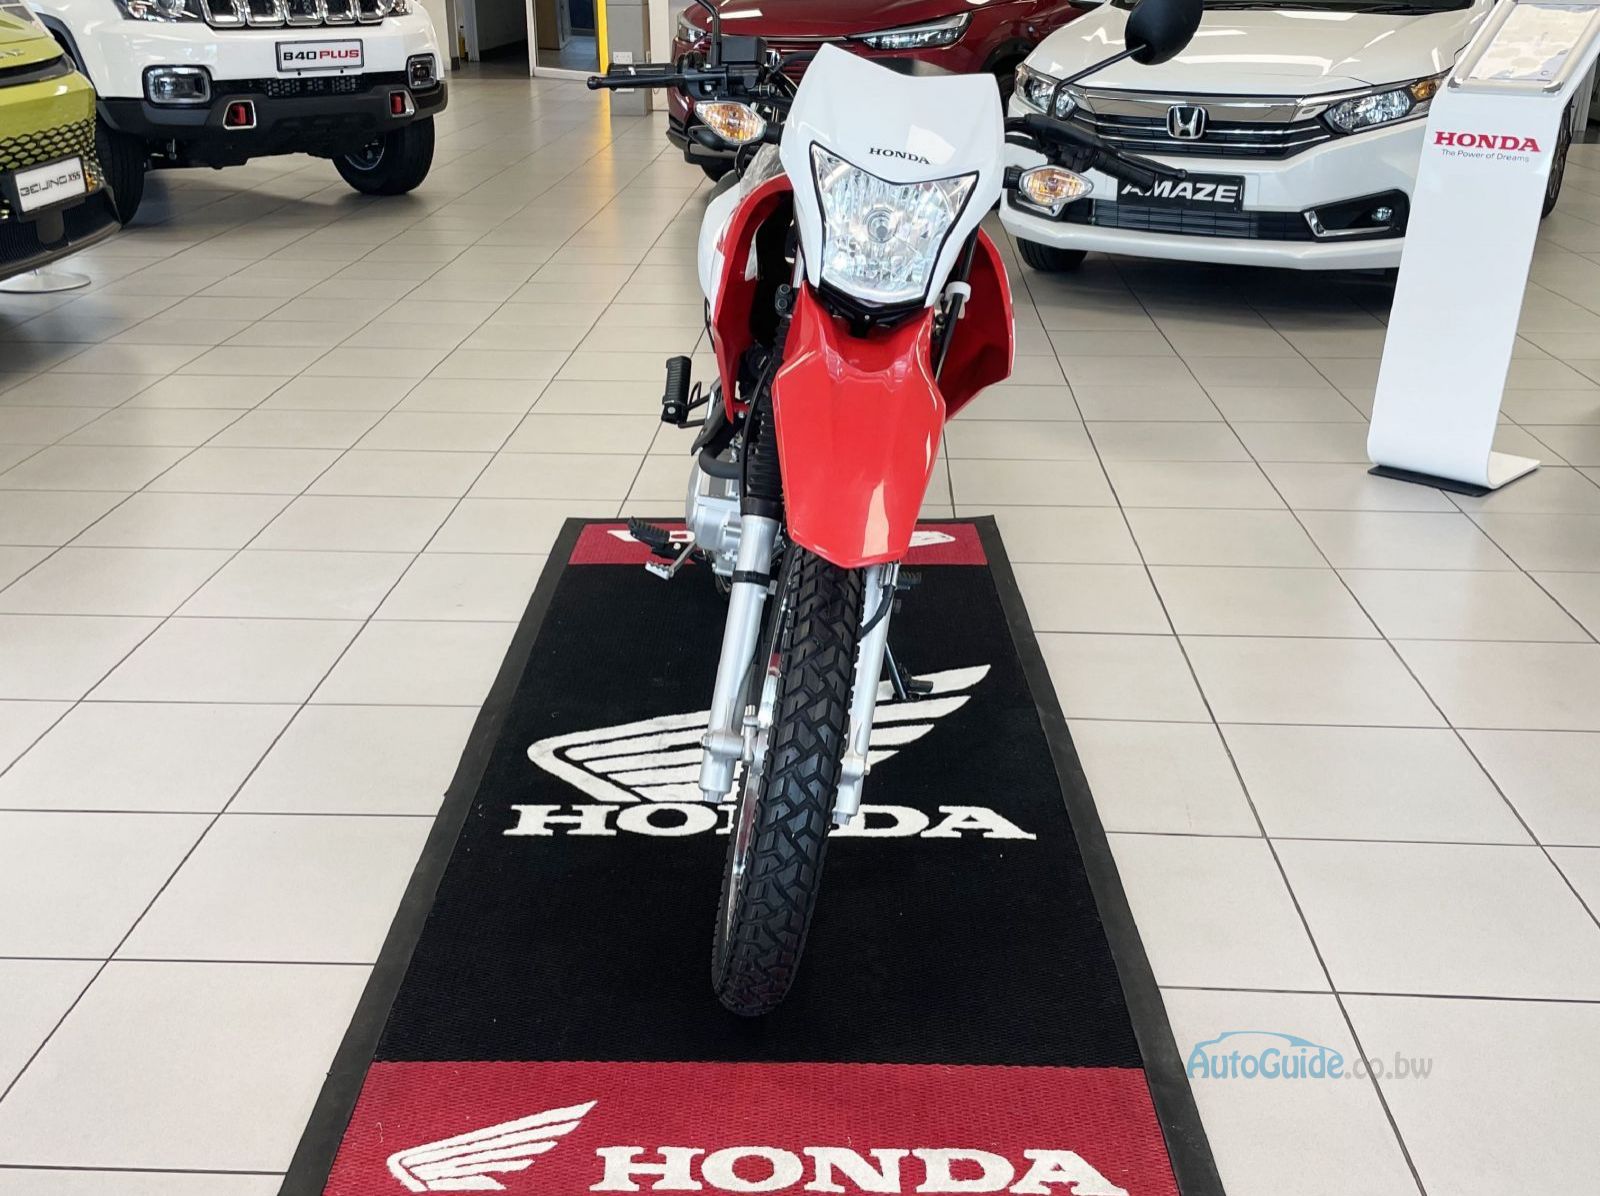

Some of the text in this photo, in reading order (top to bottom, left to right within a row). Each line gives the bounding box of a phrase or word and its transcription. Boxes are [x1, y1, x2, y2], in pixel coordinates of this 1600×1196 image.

[283, 49, 360, 61] B40 PLUS
[1434, 131, 1541, 152] HONDA
[869, 147, 931, 165] HONDA
[1457, 150, 1484, 158] Power
[1496, 153, 1530, 162] Dreams
[20, 171, 81, 197] BEIJING X55
[502, 803, 1037, 840] HODA
[589, 1146, 1130, 1196] HONDA
